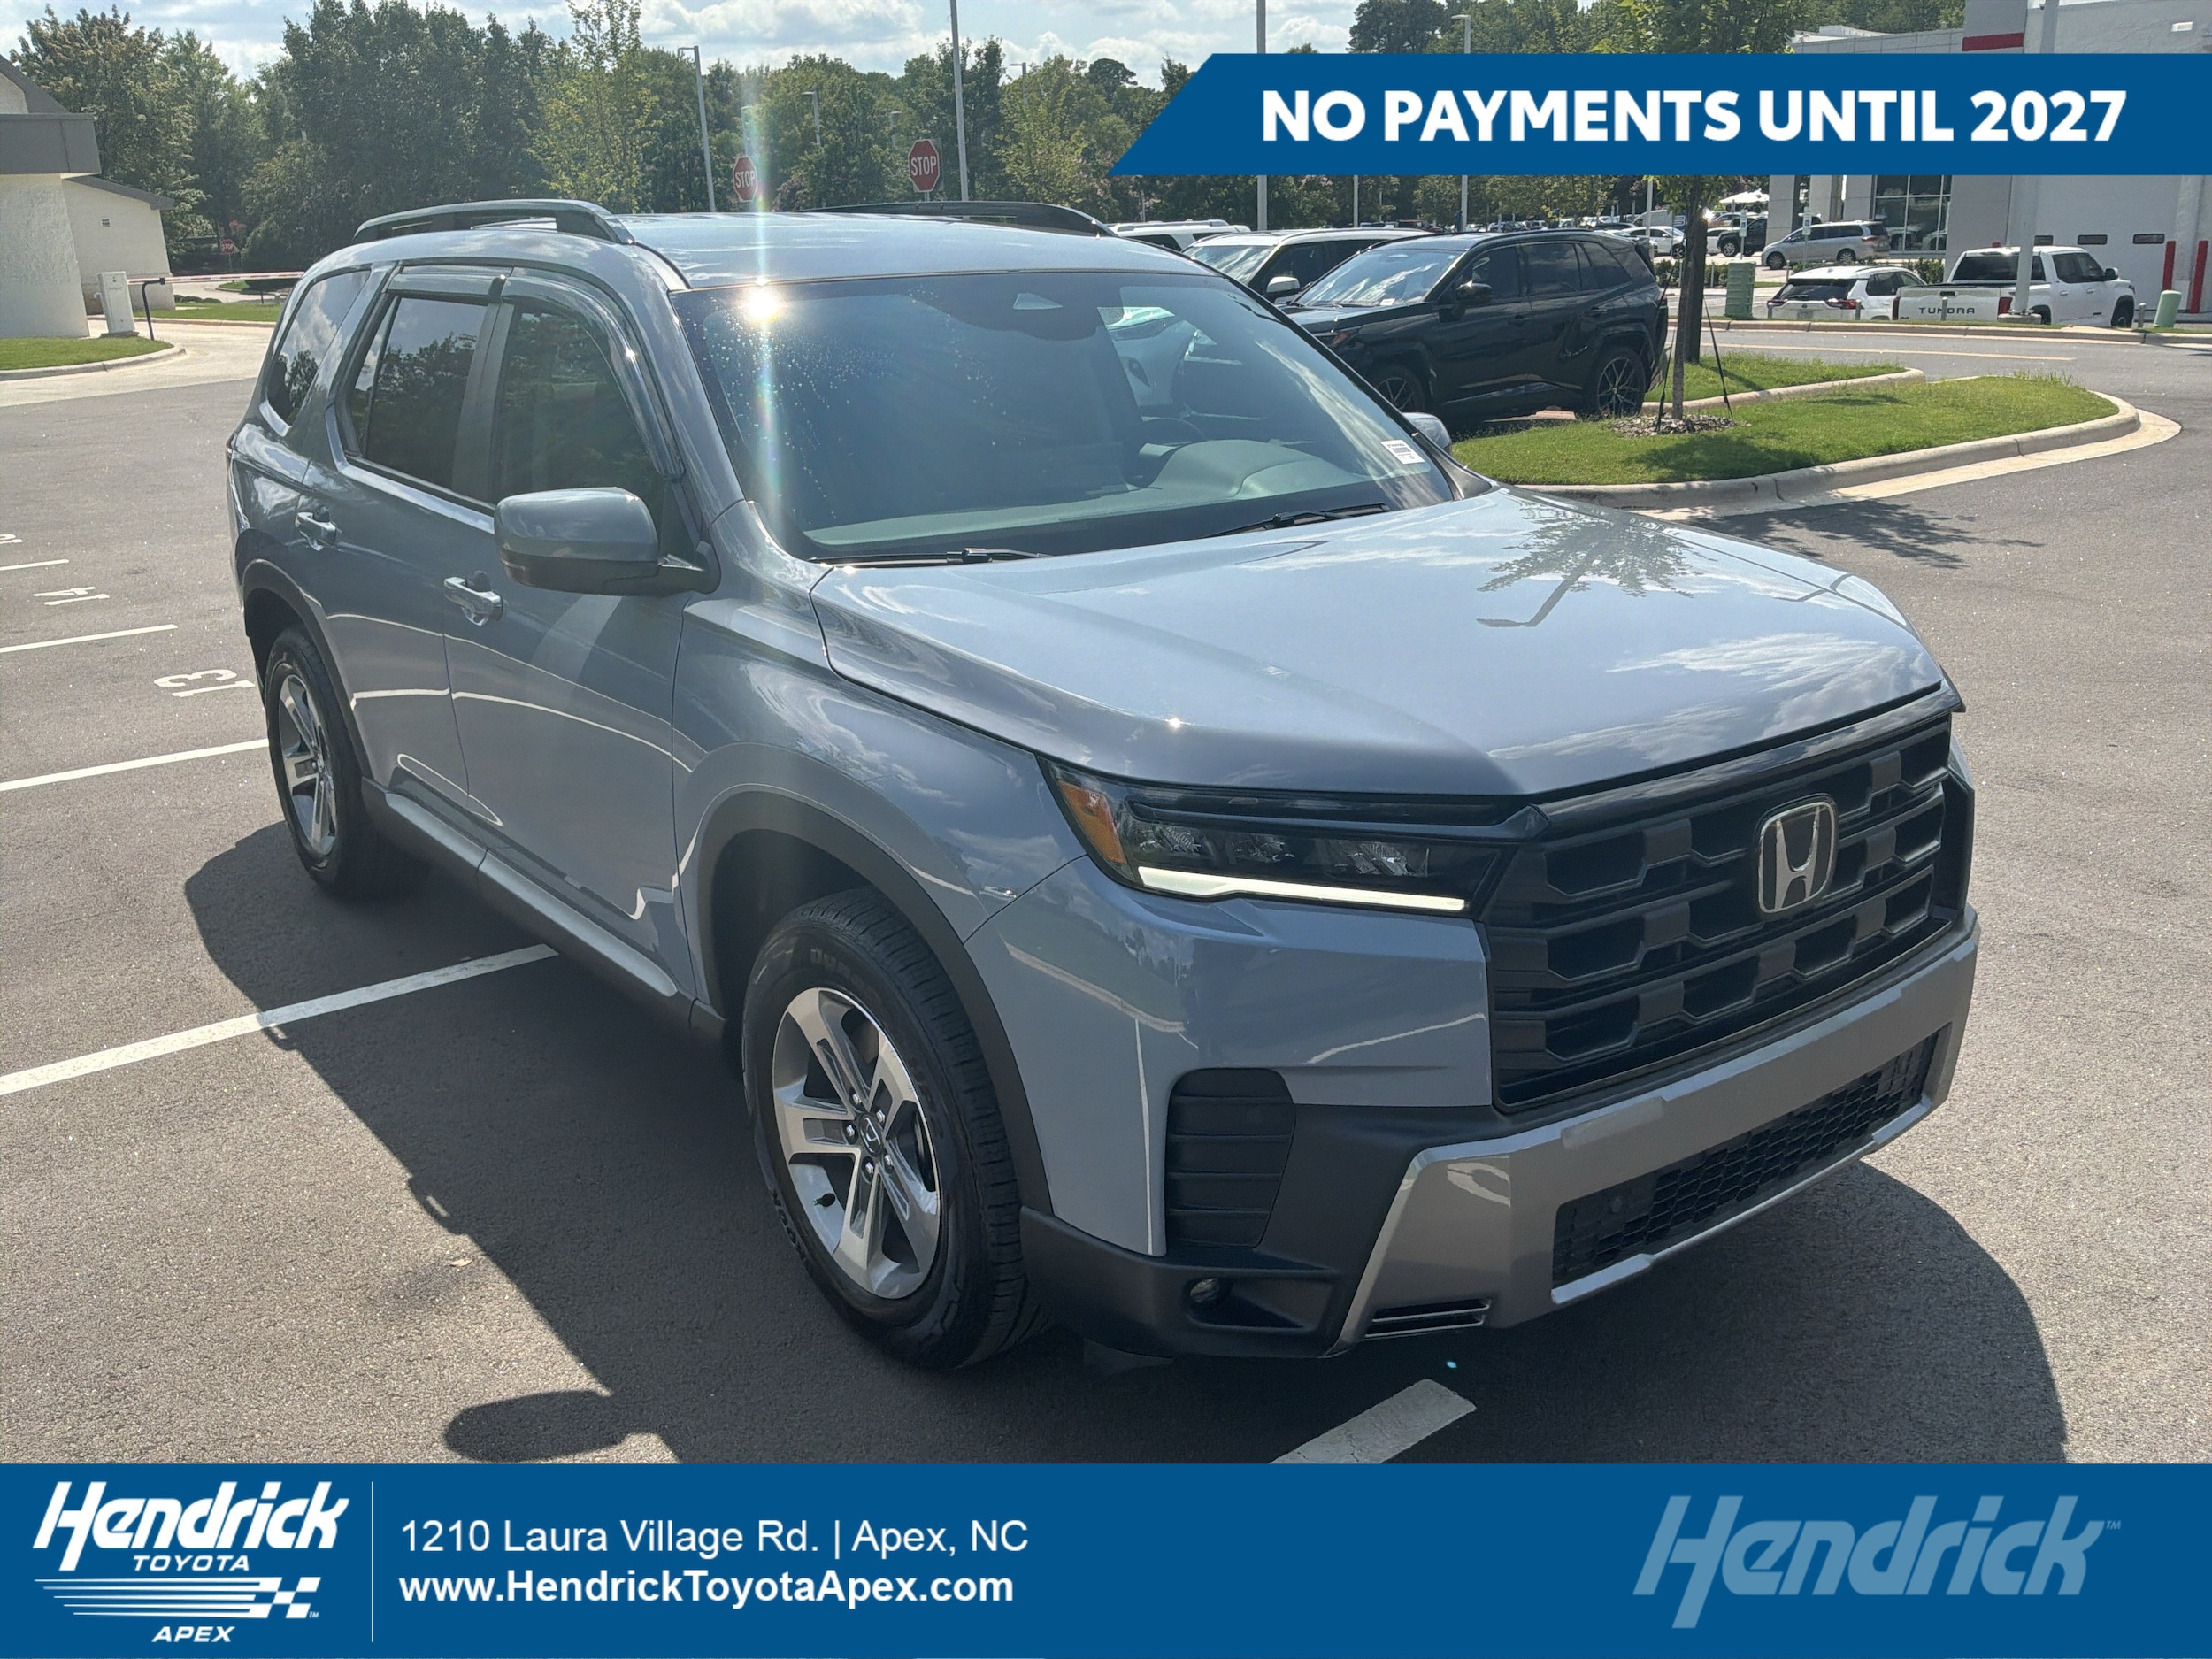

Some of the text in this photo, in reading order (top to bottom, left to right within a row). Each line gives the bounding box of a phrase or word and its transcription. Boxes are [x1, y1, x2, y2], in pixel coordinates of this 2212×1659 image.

[911, 156, 937, 176] STOP
[735, 171, 756, 188] STOP
[154, 669, 256, 697] 13
